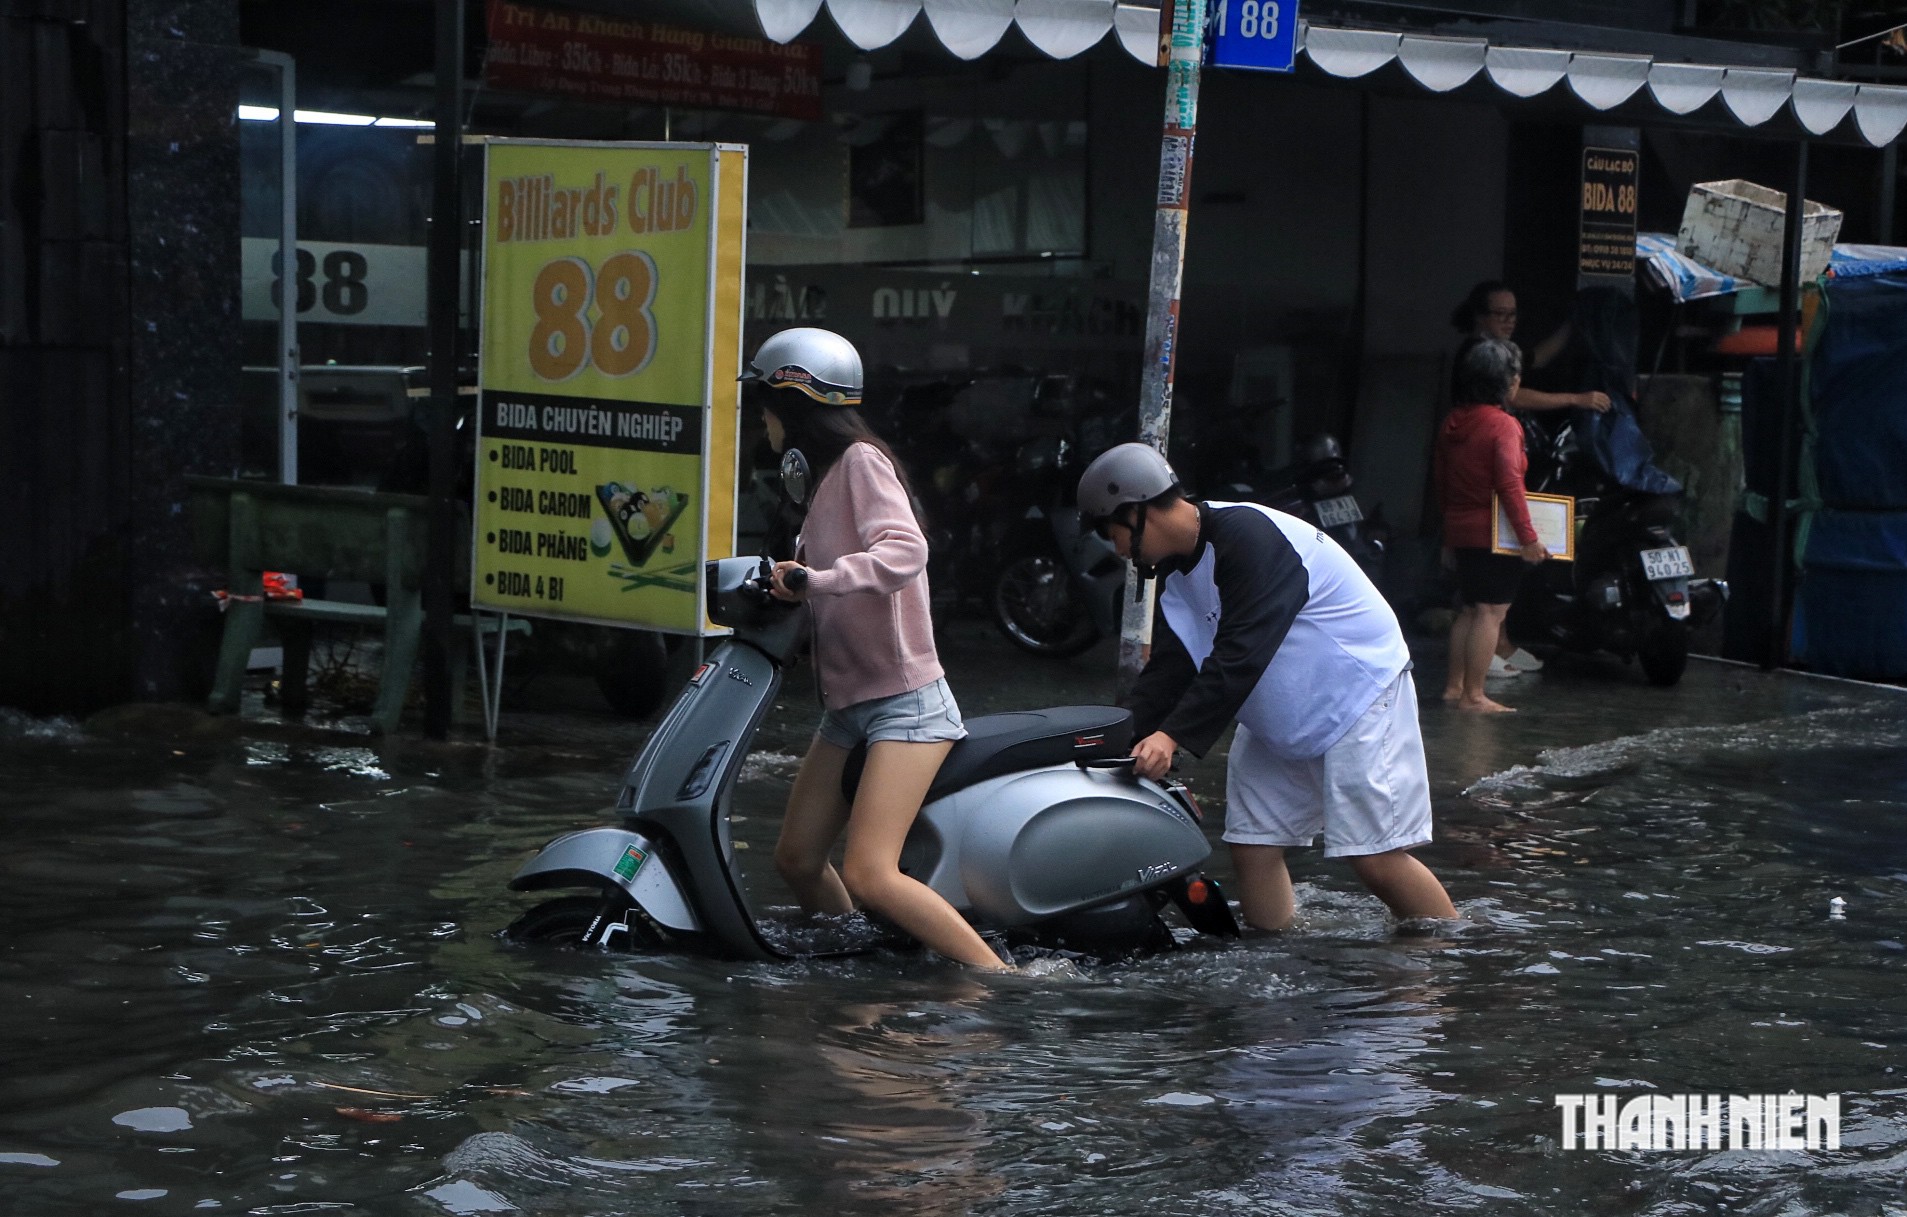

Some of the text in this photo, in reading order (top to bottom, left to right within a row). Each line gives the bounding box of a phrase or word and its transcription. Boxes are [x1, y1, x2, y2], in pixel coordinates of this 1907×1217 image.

[1240, 0, 1280, 40] 88
[497, 164, 699, 243] Billiards Club
[1583, 181, 1635, 214] BIDA 88
[271, 248, 368, 315] 88
[529, 250, 659, 383] 88
[496, 402, 683, 446] BIDA CHUYÊN NGHIỆP
[502, 444, 577, 475] BIDA POOL
[501, 486, 591, 518] BIDA CAROM
[499, 528, 587, 561] BIDA PHĂNG
[497, 571, 564, 601] BIDA 4 BI
